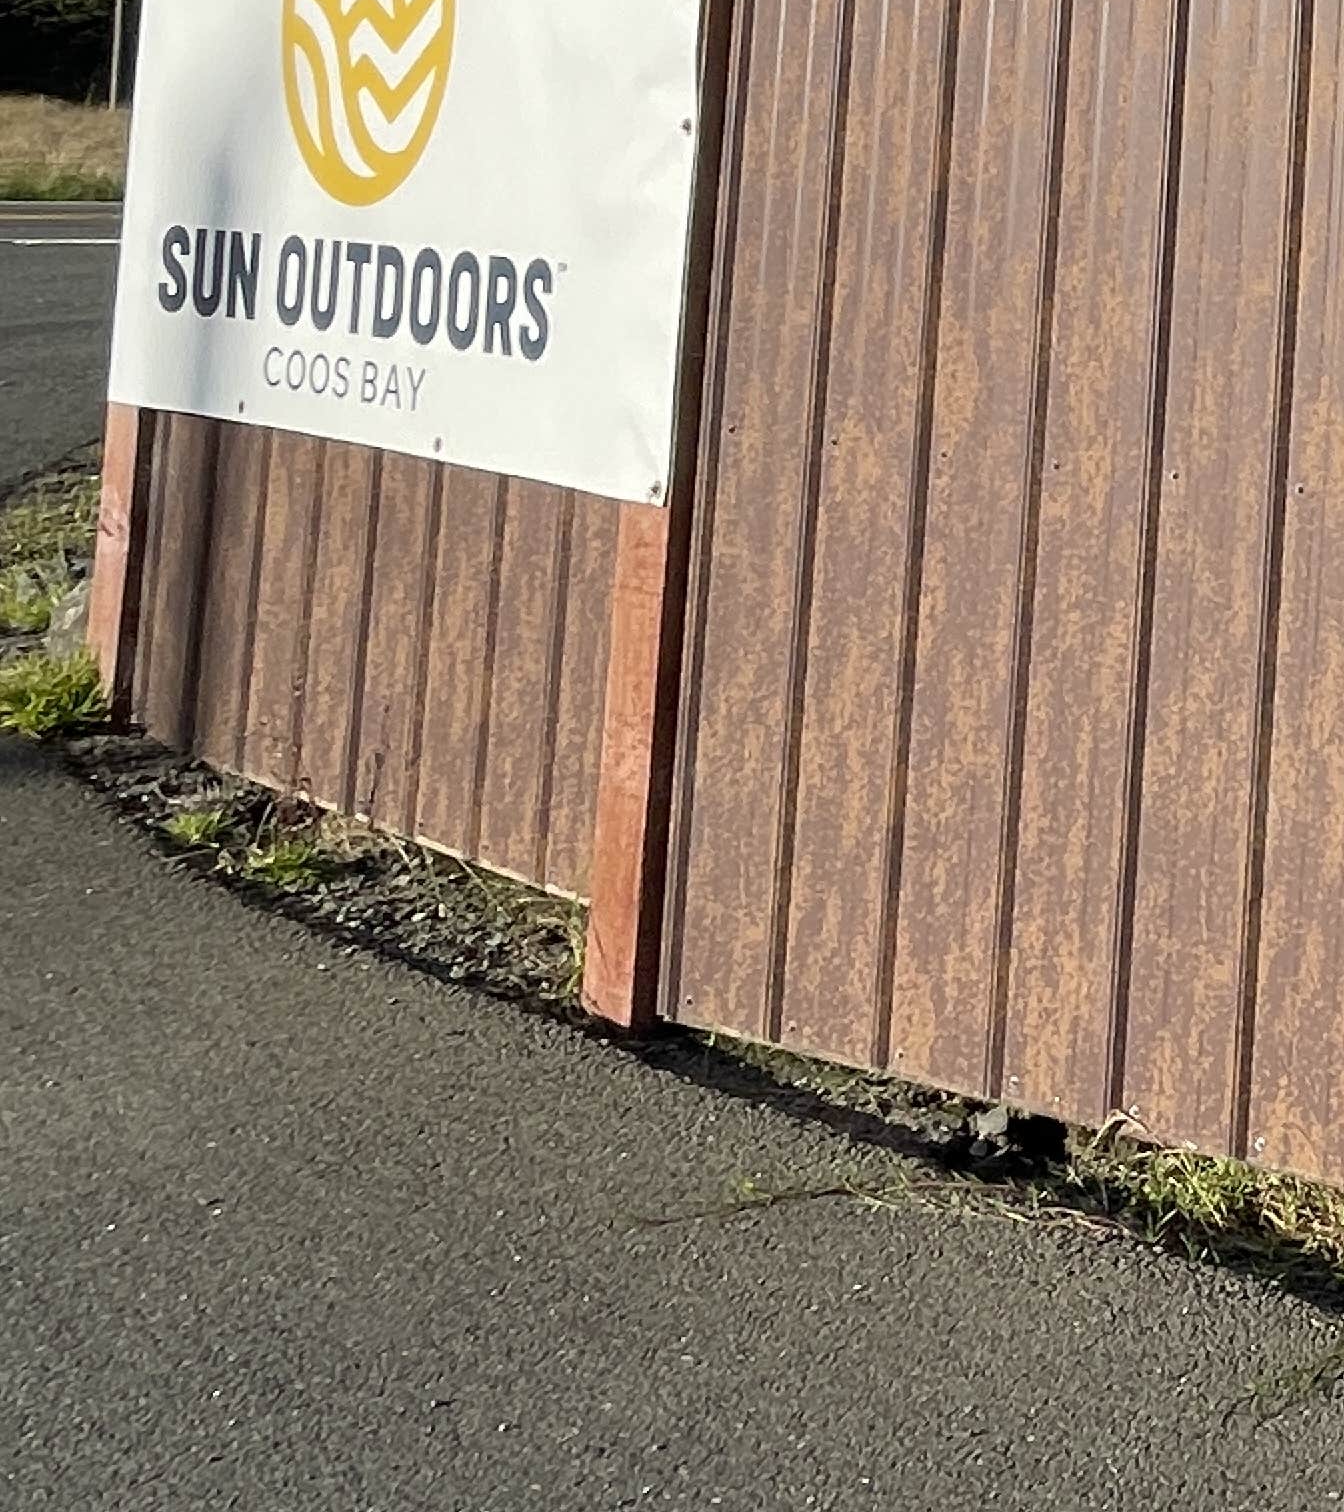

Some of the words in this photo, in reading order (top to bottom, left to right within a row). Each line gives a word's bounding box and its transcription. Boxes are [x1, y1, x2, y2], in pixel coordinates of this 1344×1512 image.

[157, 225, 262, 320] SUN
[275, 234, 553, 361] OUTDOORS
[263, 346, 348, 398] COOS
[360, 359, 427, 411] BAY
